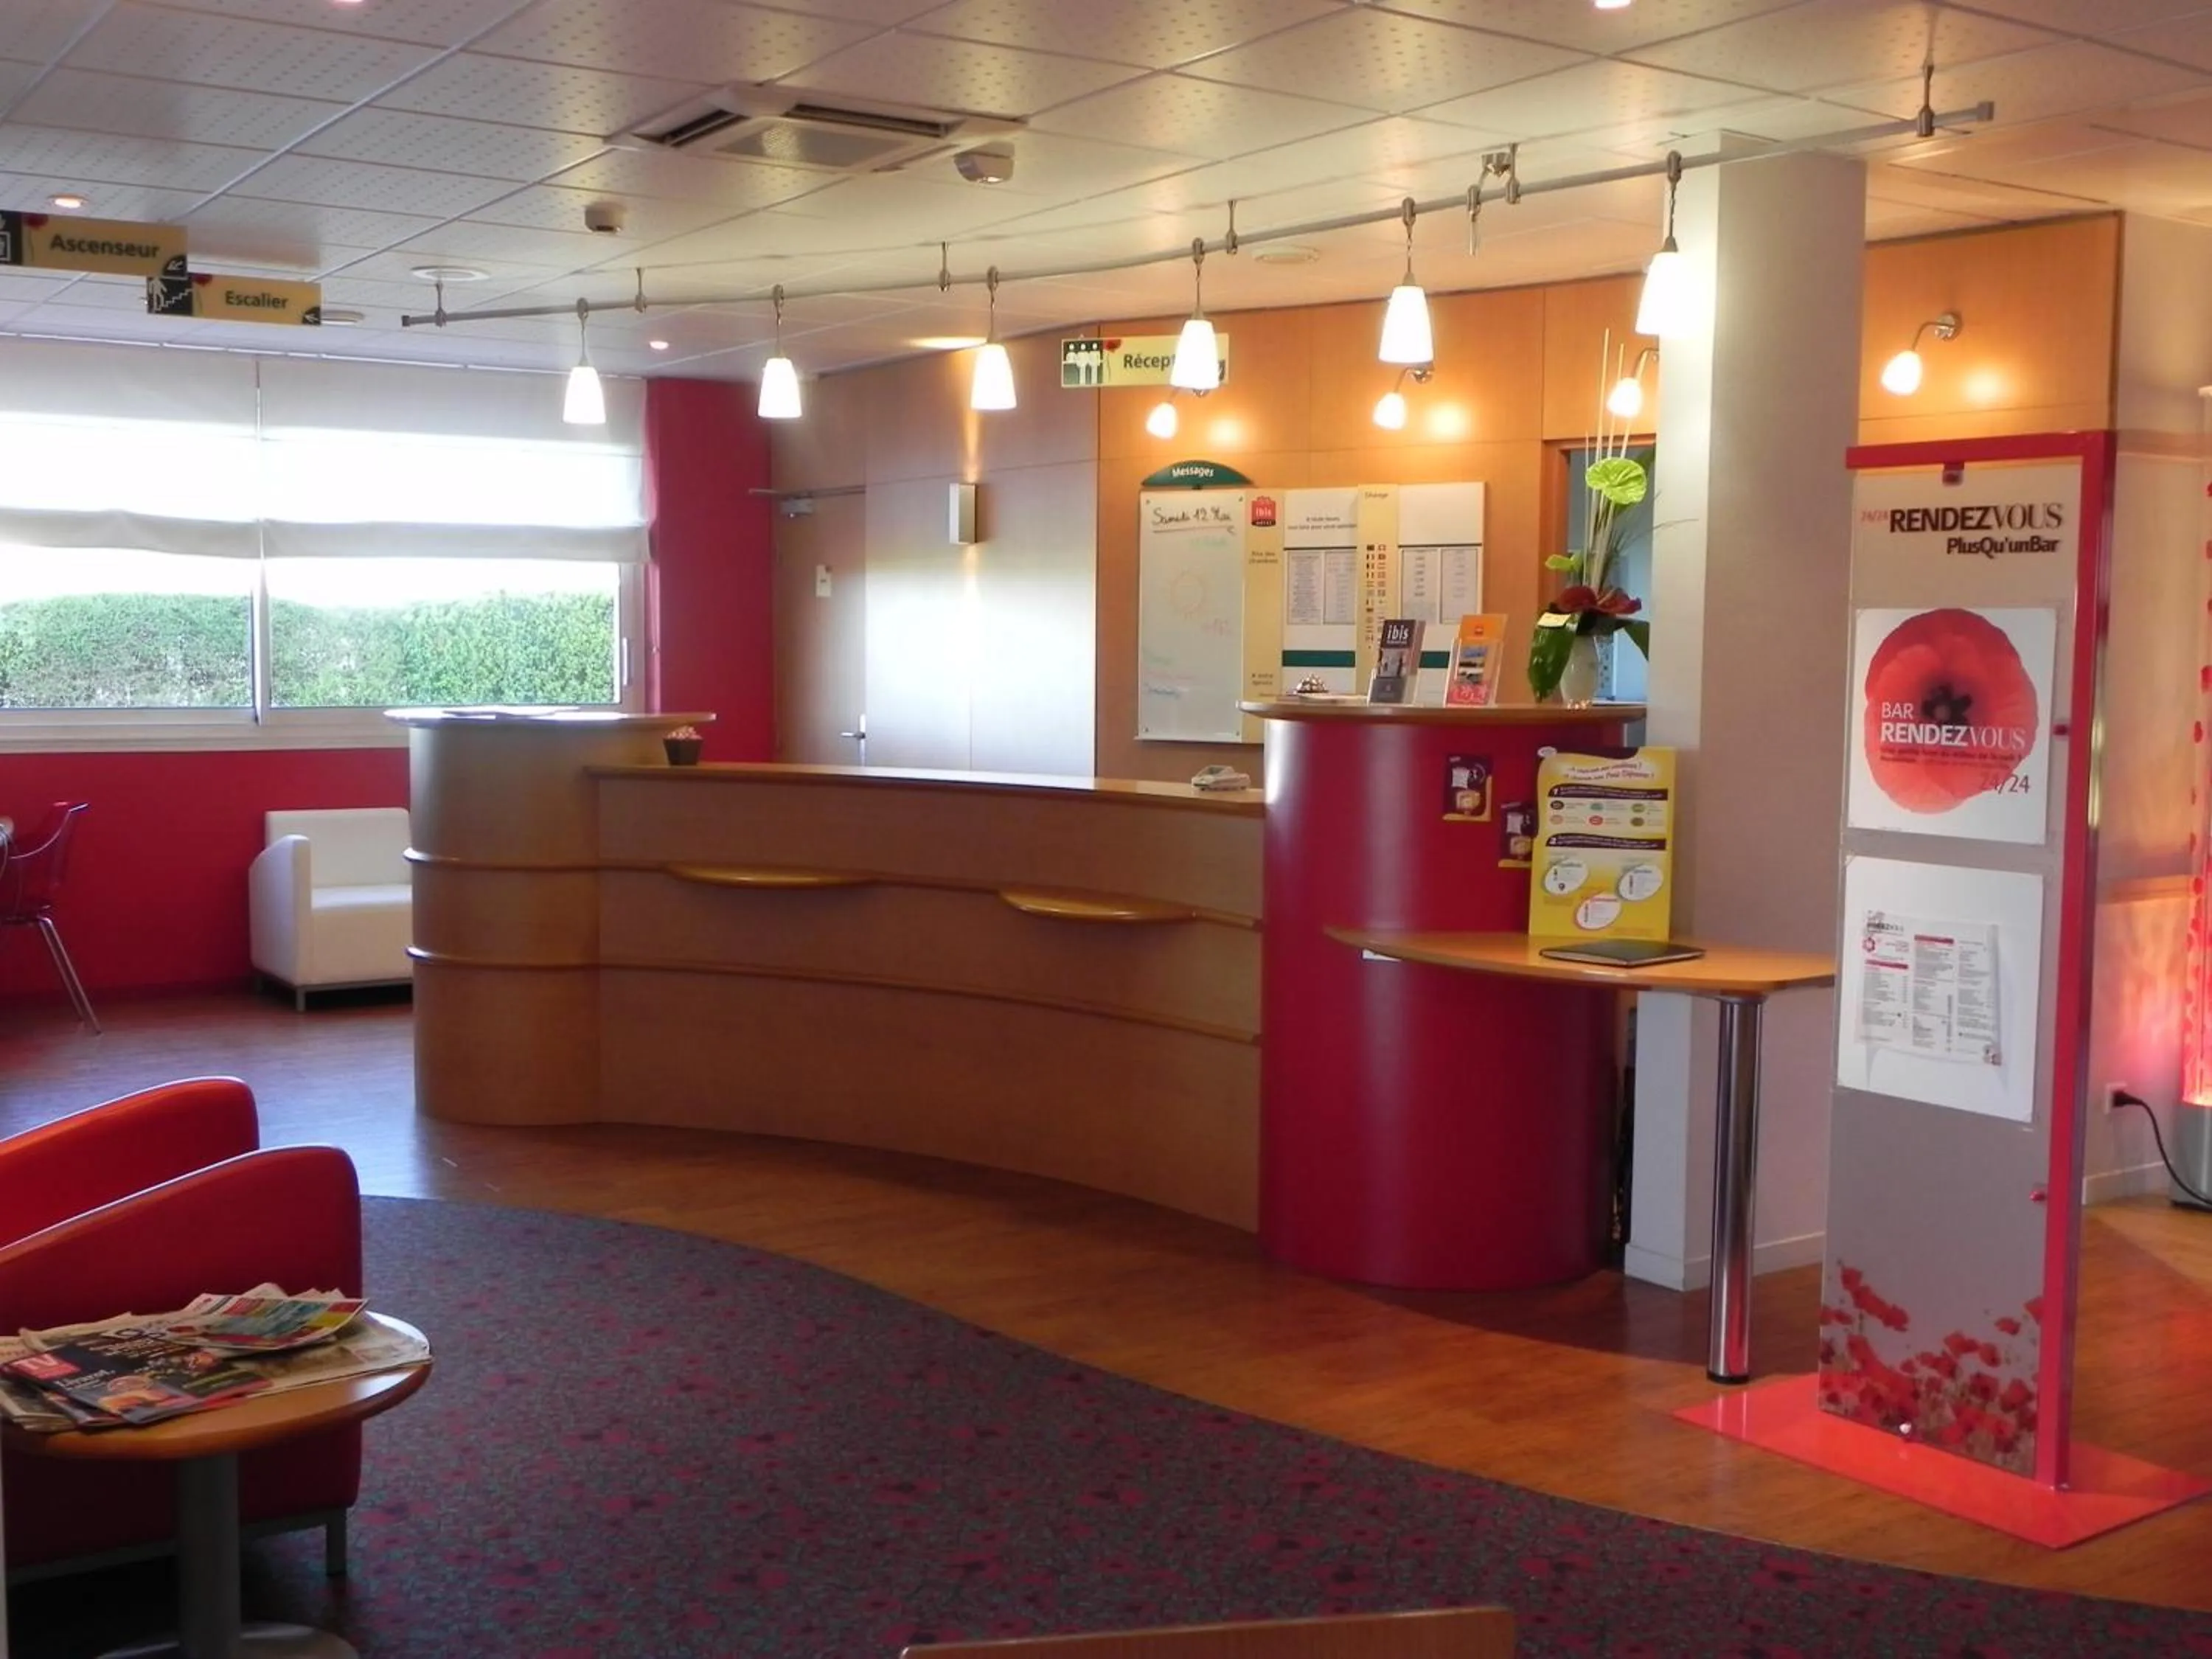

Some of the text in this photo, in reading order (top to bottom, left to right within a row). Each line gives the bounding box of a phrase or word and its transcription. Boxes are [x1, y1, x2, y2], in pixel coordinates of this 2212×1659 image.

[49, 234, 160, 258] Ascenseur
[225, 291, 289, 309] Escalier
[1123, 353, 1177, 372] Récep
[1172, 466, 1214, 478] Messages
[1191, 507, 1208, 522] 12
[1256, 507, 1273, 518] ibis
[1890, 502, 2062, 533] RENDEZVOUS
[1947, 535, 2059, 559] PlusQu'unBar
[1386, 625, 1409, 640] ibis
[1881, 701, 1914, 720] BAR
[1880, 722, 2026, 750] RENDEZVOUS
